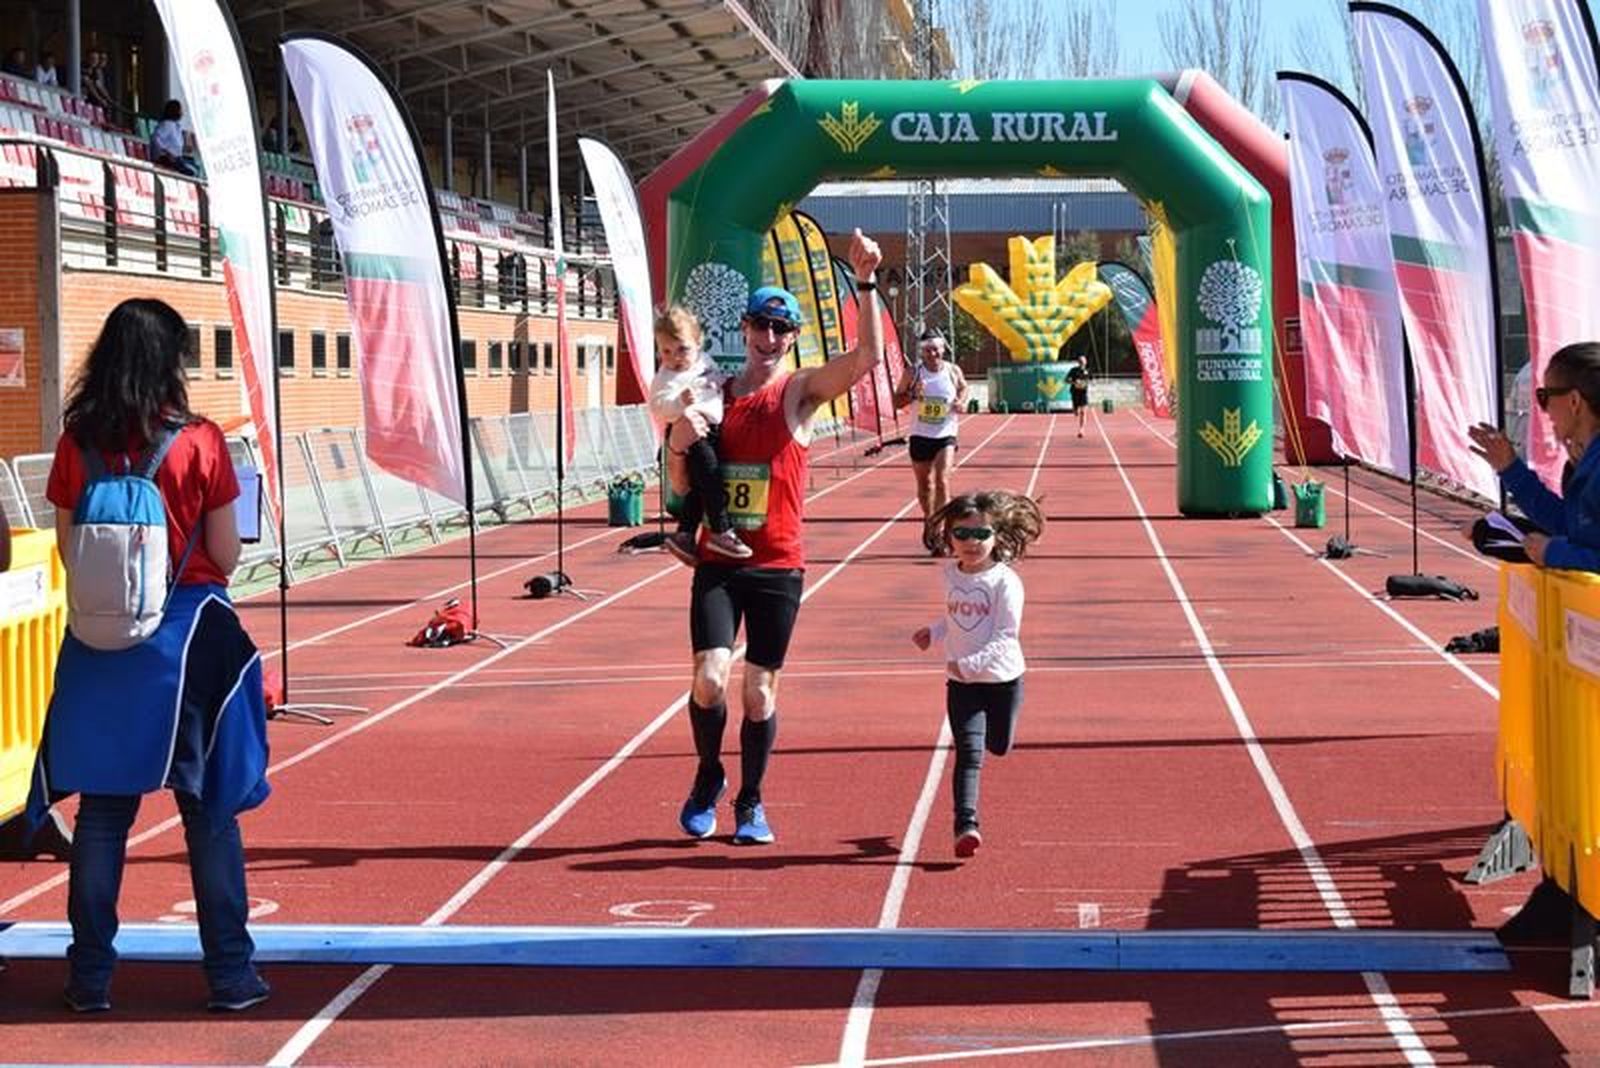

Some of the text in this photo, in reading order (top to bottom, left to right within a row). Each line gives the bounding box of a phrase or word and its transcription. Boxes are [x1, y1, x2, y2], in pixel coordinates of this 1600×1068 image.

[891, 111, 1119, 143] CAJA RURAL
[948, 601, 990, 616] WOW
